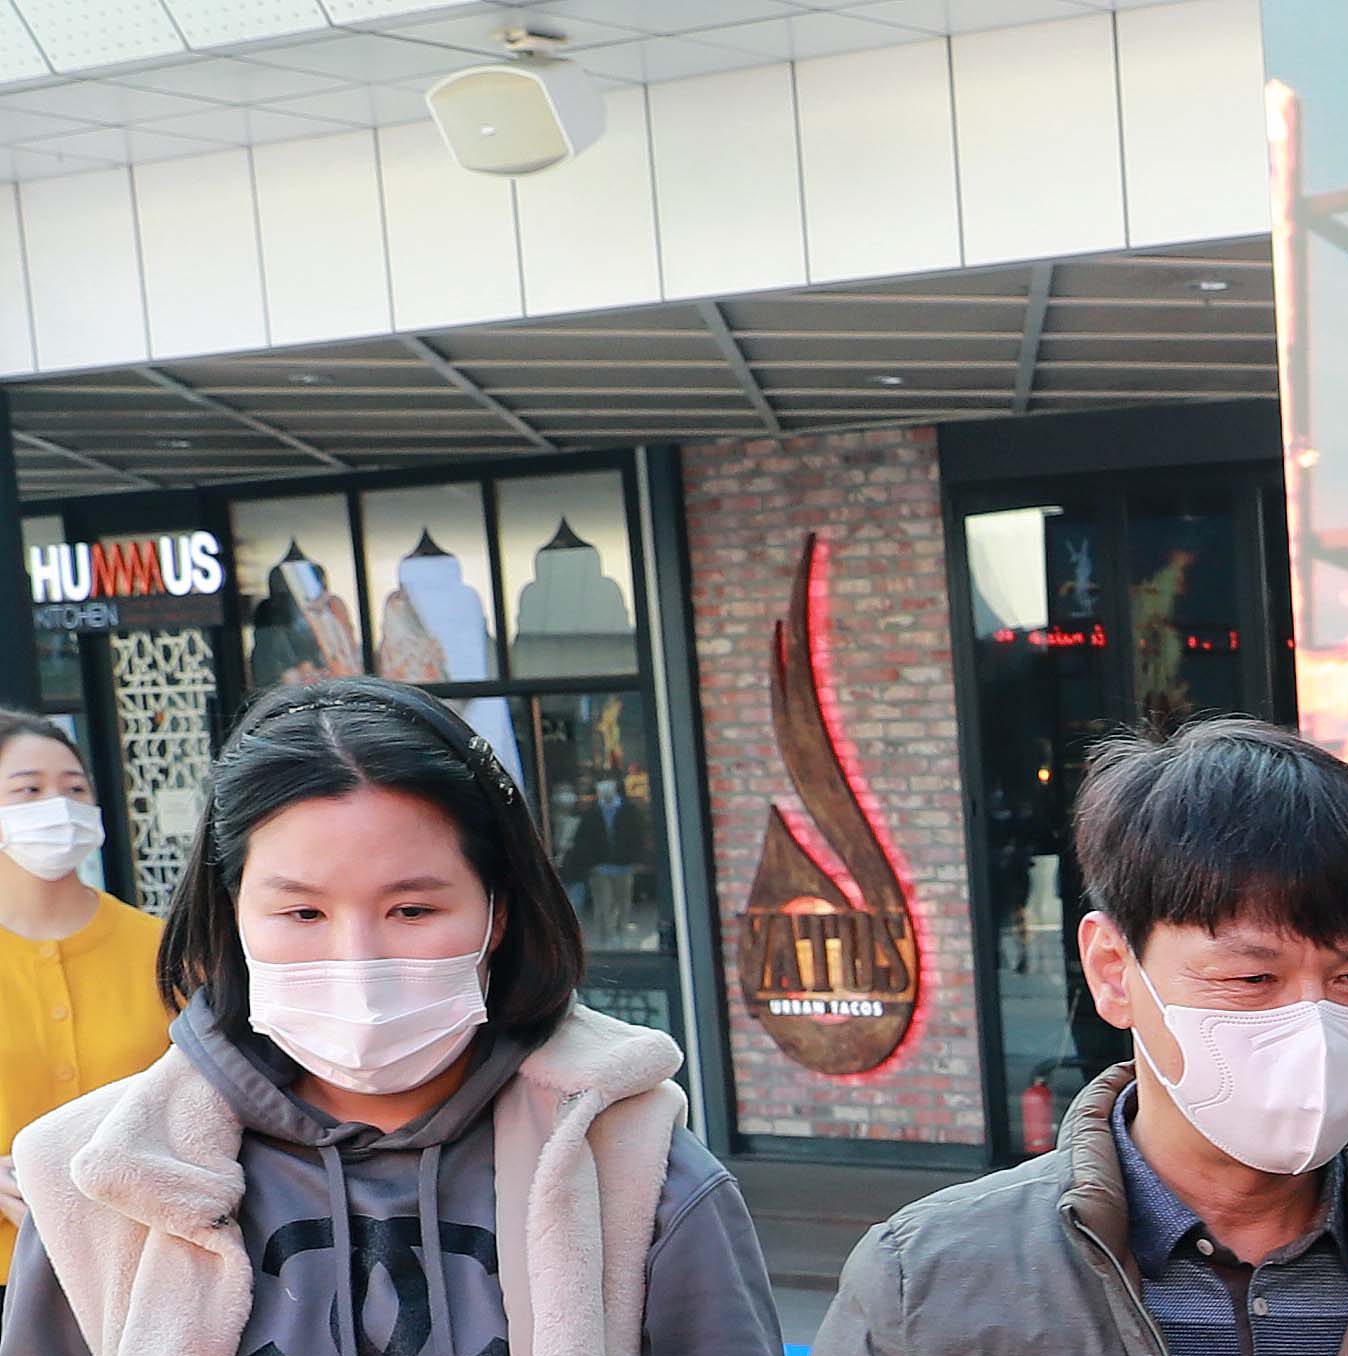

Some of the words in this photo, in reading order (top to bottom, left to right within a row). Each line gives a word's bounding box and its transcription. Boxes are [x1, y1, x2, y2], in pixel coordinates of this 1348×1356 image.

[29, 530, 224, 603] HUMMUS
[769, 999, 826, 1016] URBAN
[828, 999, 884, 1016] TACOS
